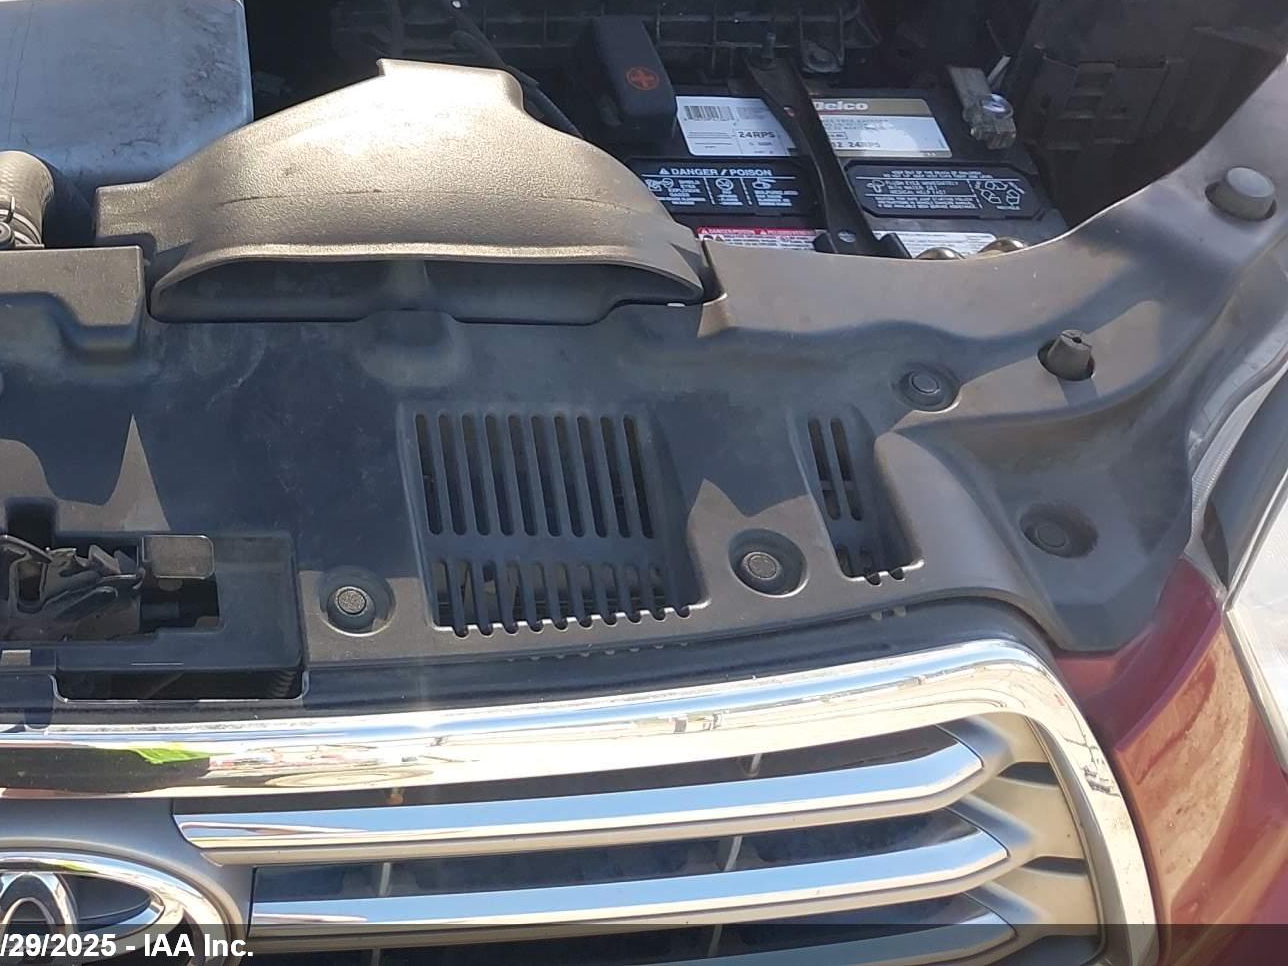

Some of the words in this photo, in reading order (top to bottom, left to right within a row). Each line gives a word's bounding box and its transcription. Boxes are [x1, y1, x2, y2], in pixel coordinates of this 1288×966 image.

[738, 131, 776, 139] 24RPS
[671, 168, 718, 176] DANGER
[729, 168, 773, 177] POISON
